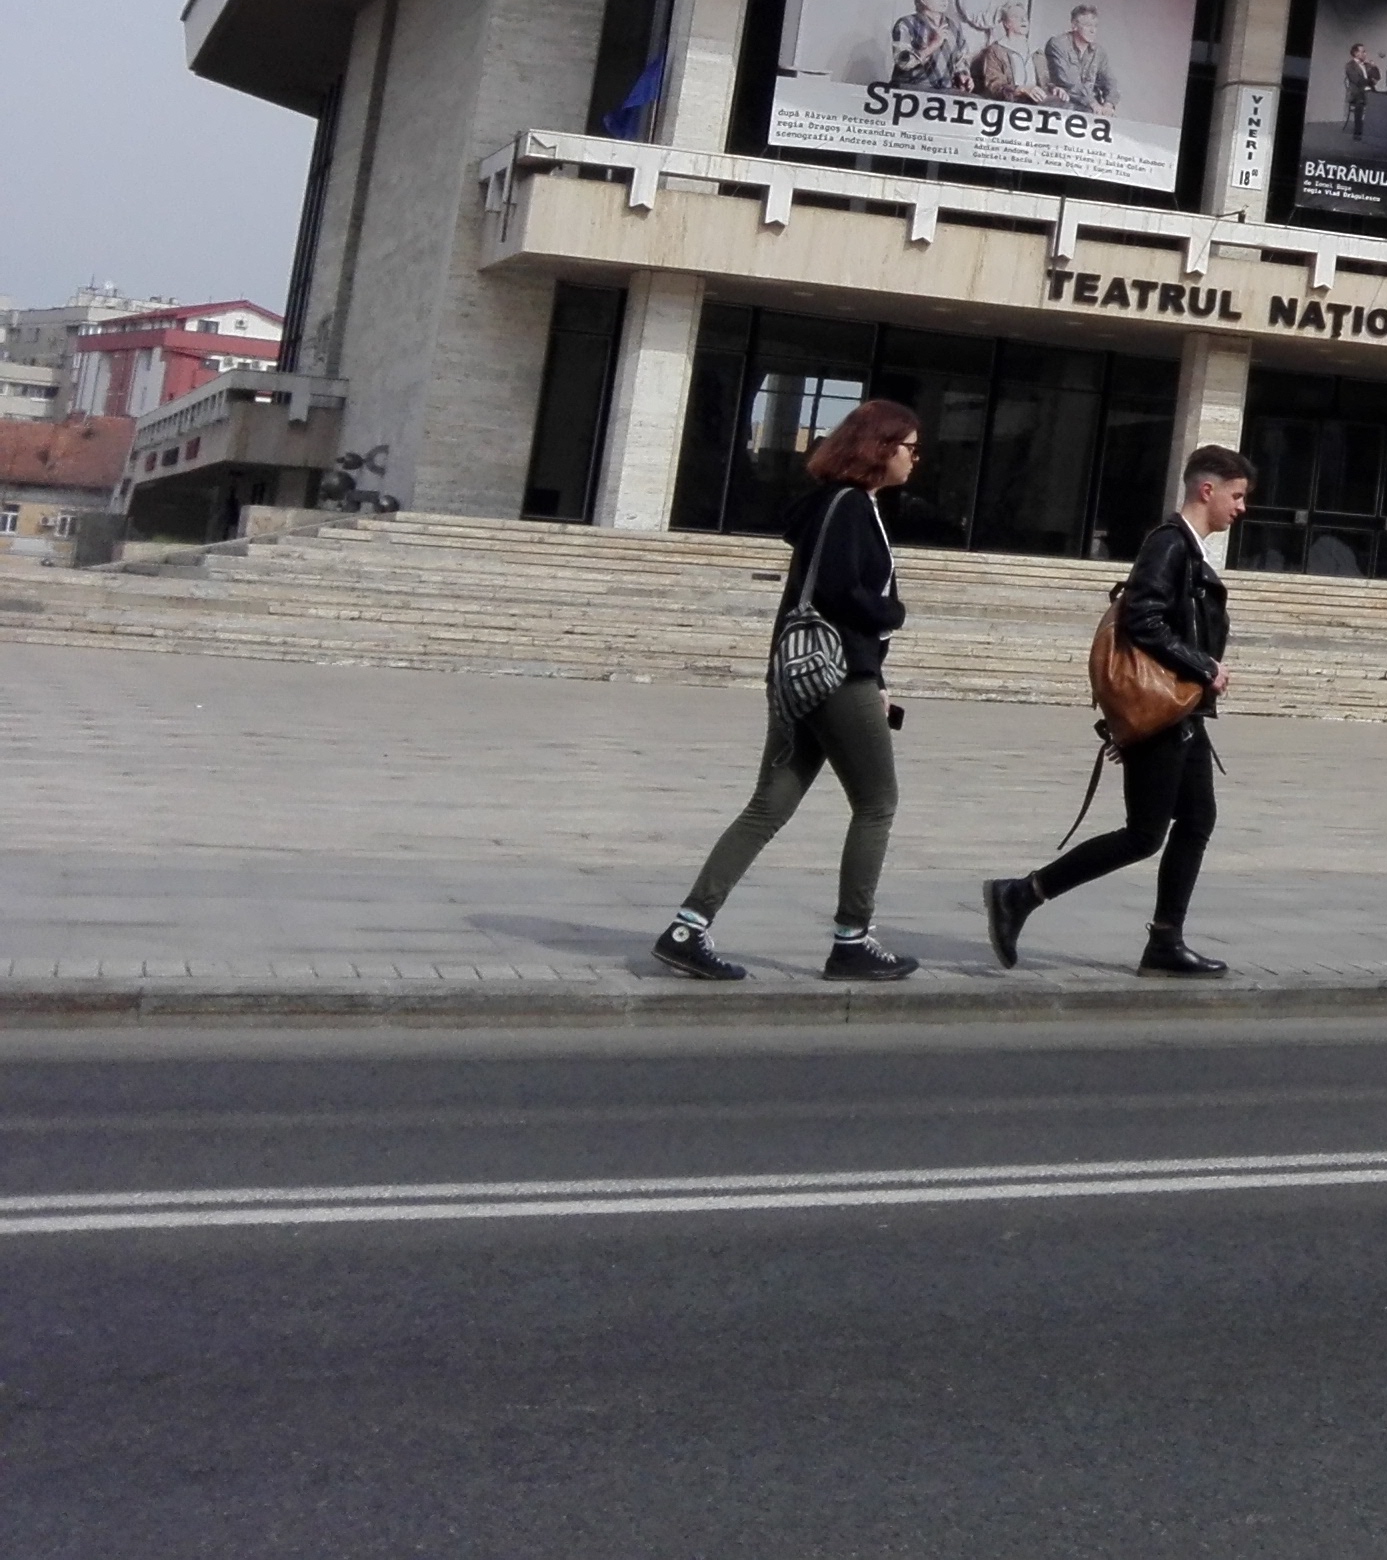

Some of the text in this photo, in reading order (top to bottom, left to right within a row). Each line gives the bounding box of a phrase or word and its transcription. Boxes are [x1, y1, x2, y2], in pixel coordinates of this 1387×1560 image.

[842, 115, 887, 126] Petrescu
[864, 81, 1112, 143] Spargerea
[777, 120, 803, 129] regia
[846, 126, 895, 138] Alexandru
[1246, 95, 1263, 160] VINERI
[776, 130, 834, 142] scenografia
[840, 136, 877, 146] Andreea
[883, 141, 915, 150] Simona
[1304, 187, 1322, 196] regia
[1325, 188, 1341, 197] Vlad
[1047, 269, 1242, 320] TEATRUL
